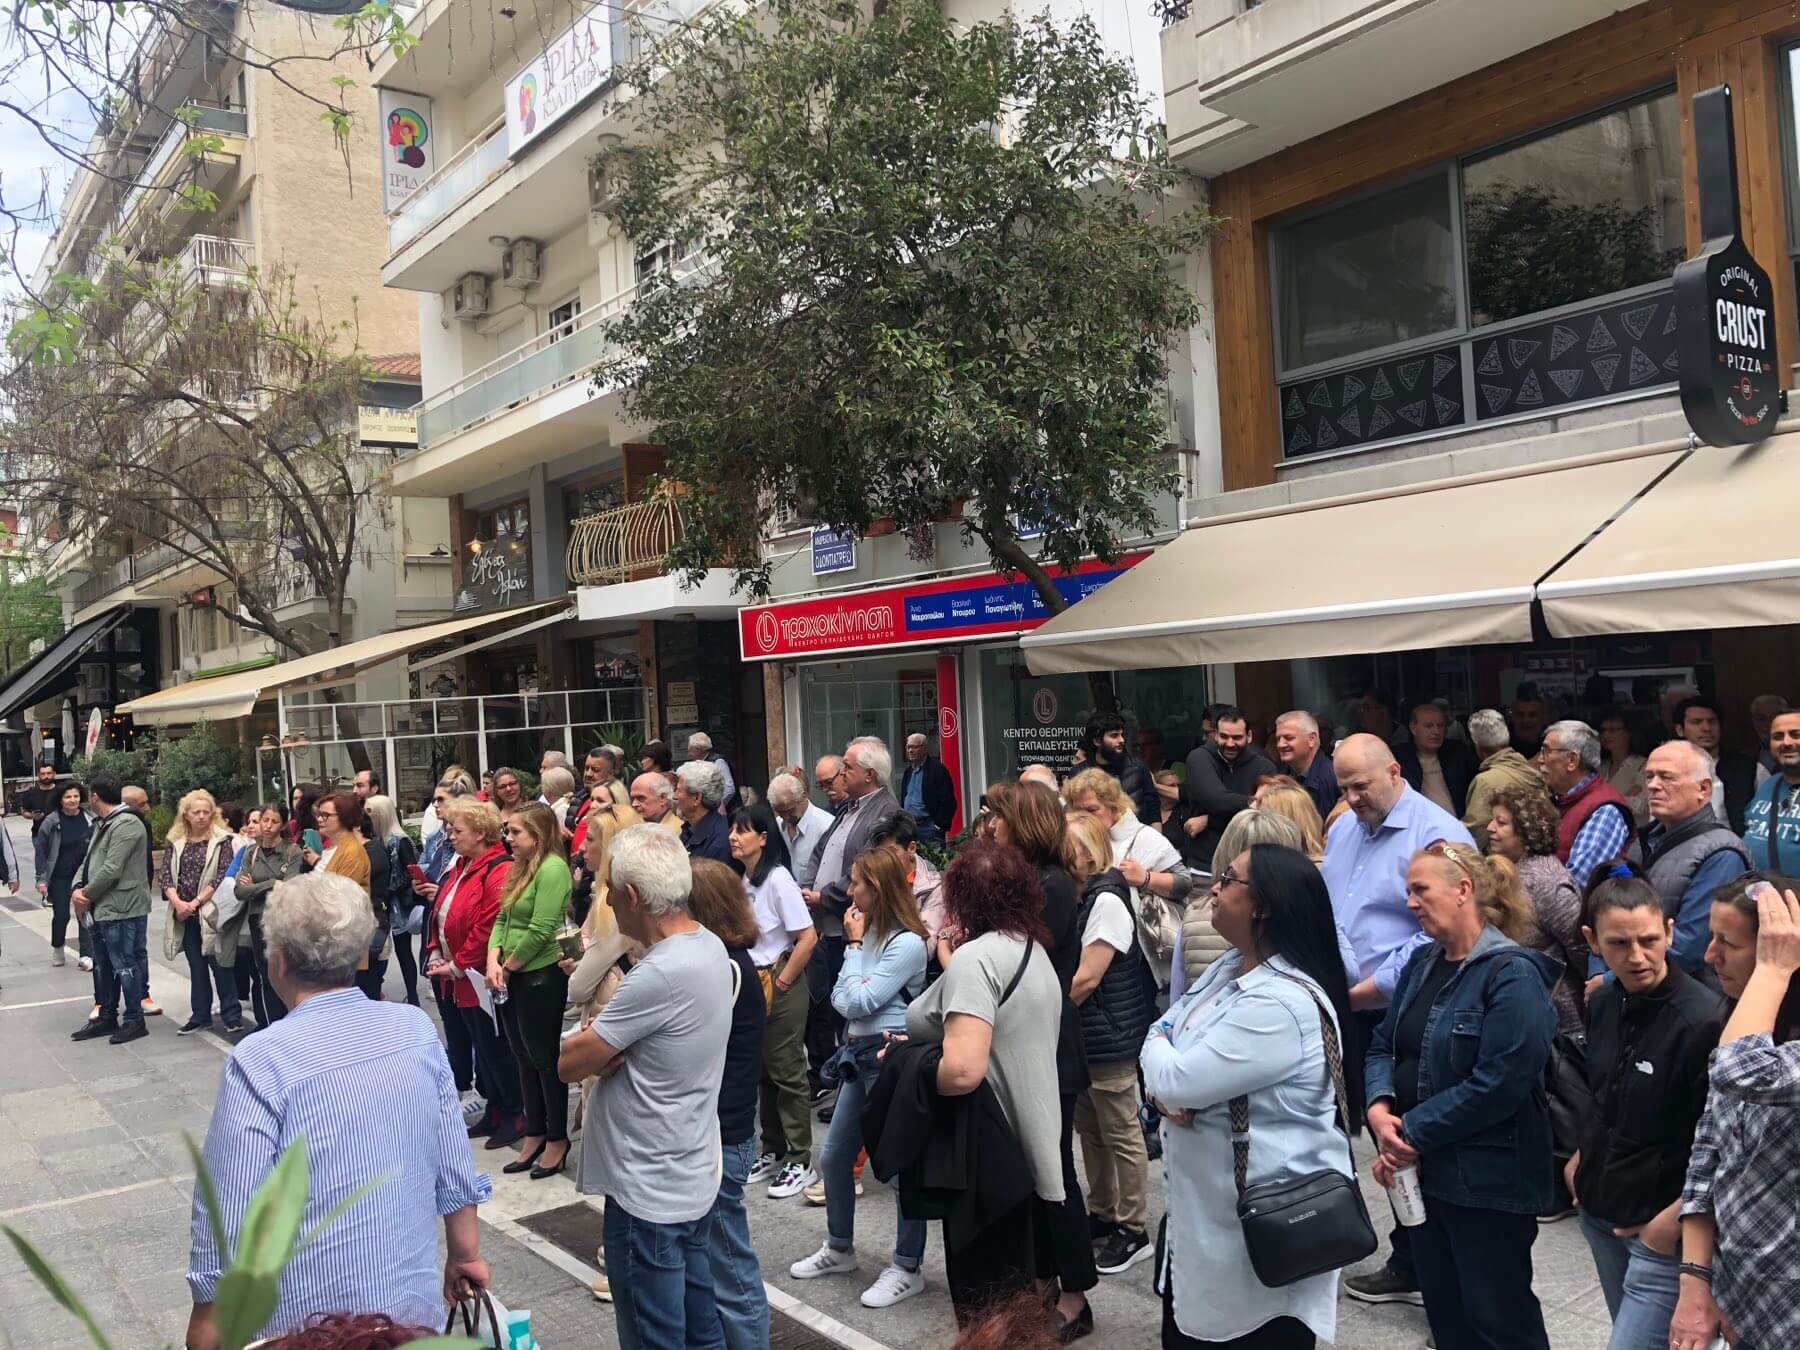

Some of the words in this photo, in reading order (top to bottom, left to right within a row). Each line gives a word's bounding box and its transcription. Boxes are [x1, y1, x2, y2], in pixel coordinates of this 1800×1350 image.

[1720, 266, 1758, 298] ORIGINAL
[1716, 298, 1766, 350] CRUST
[1727, 353, 1762, 374] PIZZA
[781, 605, 894, 648] τροχοκίνηση
[794, 639, 818, 647] ΚΕΝΤΡΟ
[1003, 728, 1037, 738] ΚΕΝΤΡΟ
[1019, 741, 1079, 751] ΕΚΠΑΙΔΕΥΣΗΣ
